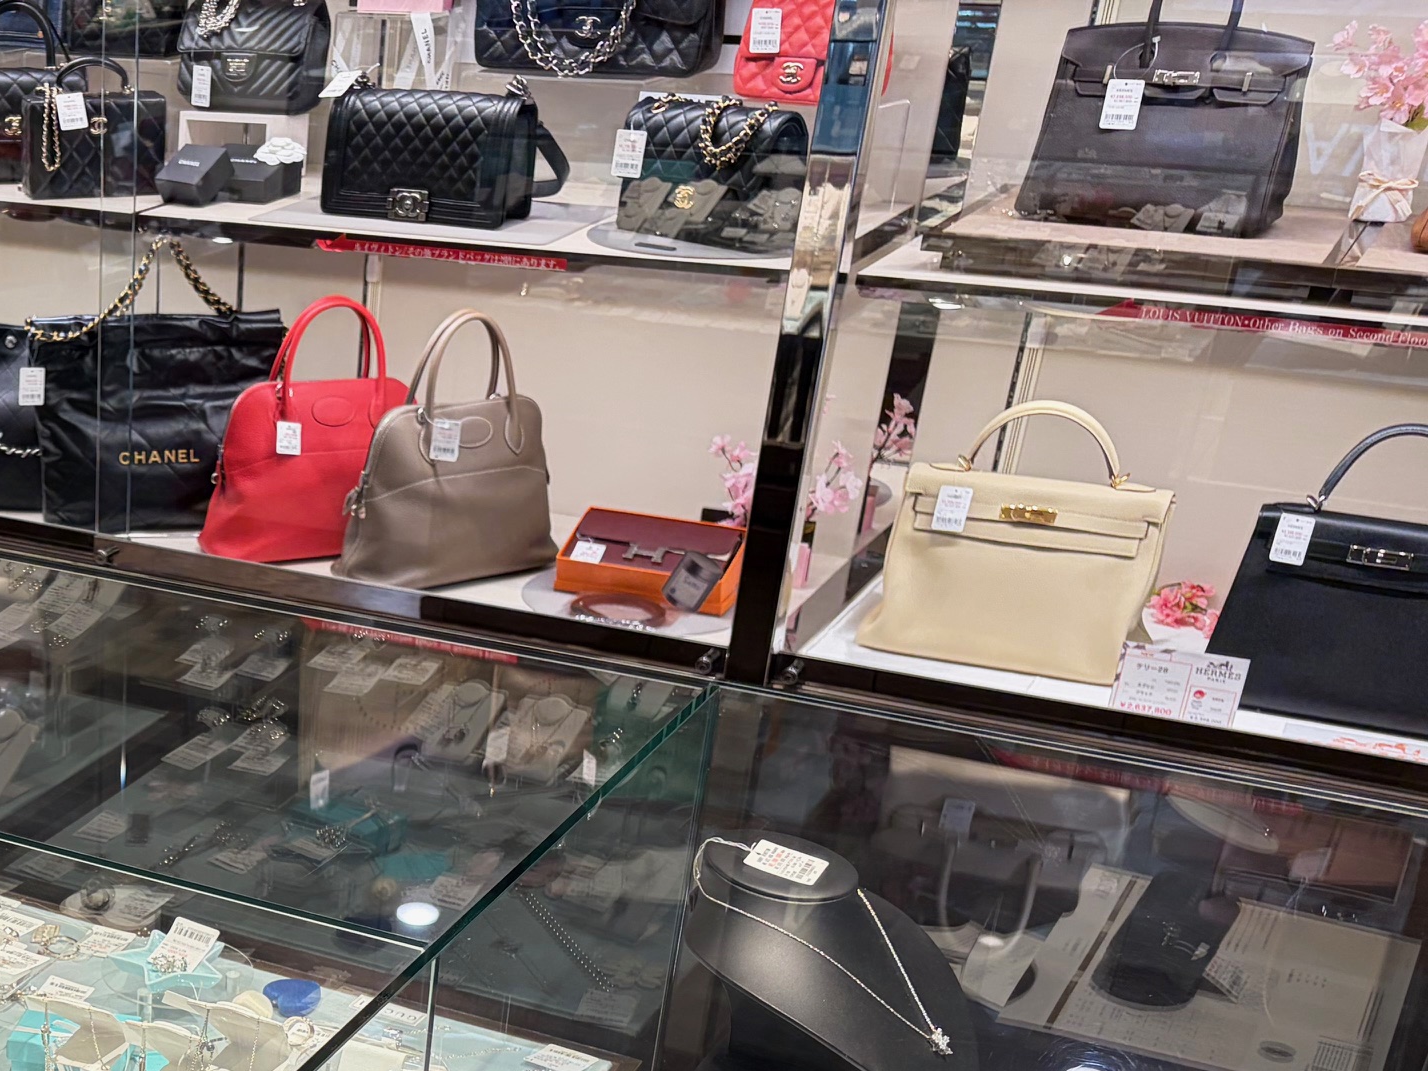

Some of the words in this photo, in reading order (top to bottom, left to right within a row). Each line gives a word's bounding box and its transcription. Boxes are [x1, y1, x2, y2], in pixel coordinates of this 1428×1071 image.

[1141, 308, 1180, 320] LOUIS
[1289, 321, 1324, 337] Bags
[1329, 328, 1344, 338] on
[1348, 328, 1395, 343] Second
[118, 449, 200, 465] CHANEL
